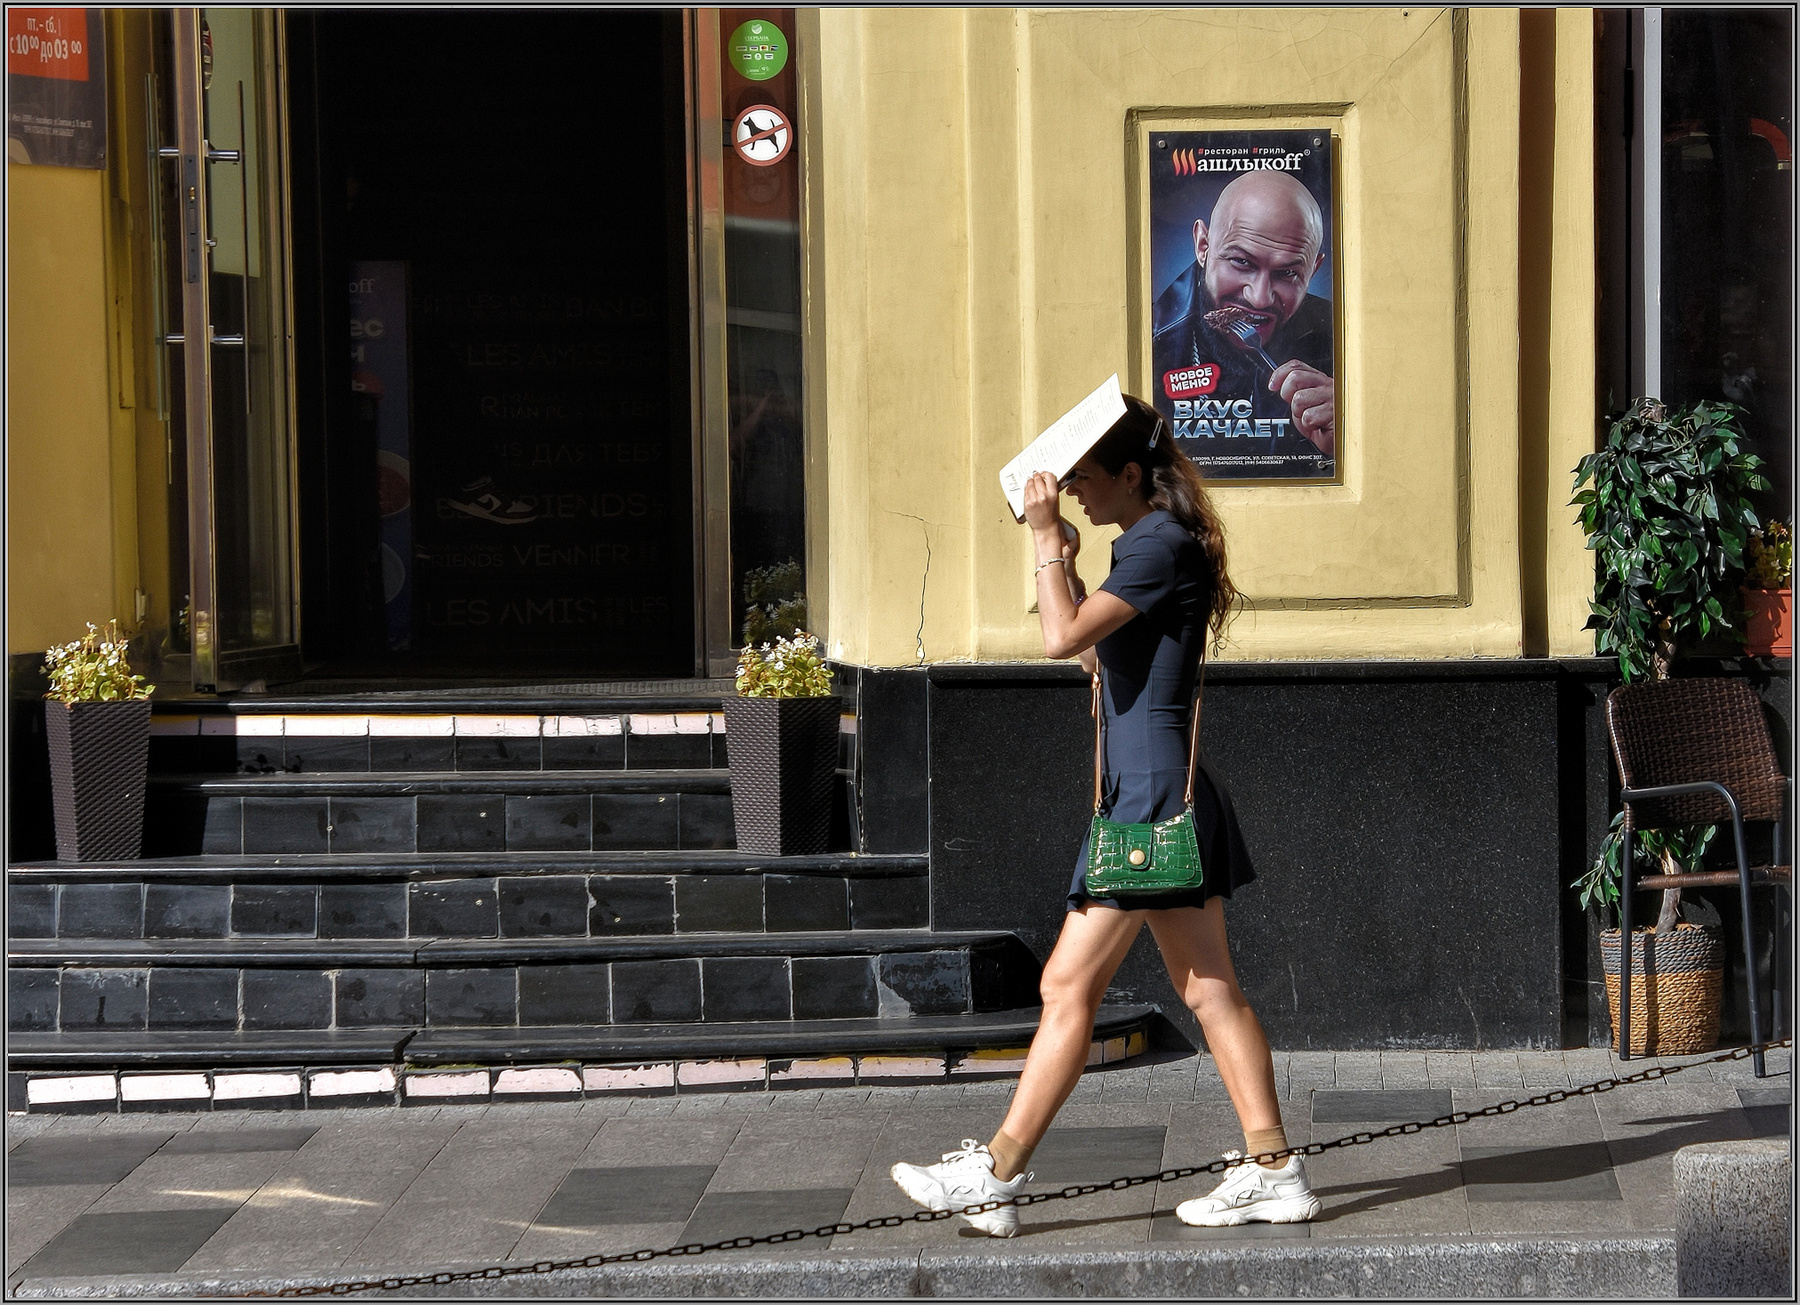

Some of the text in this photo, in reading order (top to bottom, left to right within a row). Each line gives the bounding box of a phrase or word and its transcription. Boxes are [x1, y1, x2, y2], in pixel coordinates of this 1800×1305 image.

[45, 16, 57, 33] сб.
[40, 41, 53, 63] до
[1252, 147, 1286, 155] #гриль
[1169, 366, 1213, 383] НОВОЕ
[1171, 377, 1211, 393] МЕНЮ
[1173, 399, 1253, 419] ВКУС
[1173, 418, 1291, 439] КАЧАЕТ
